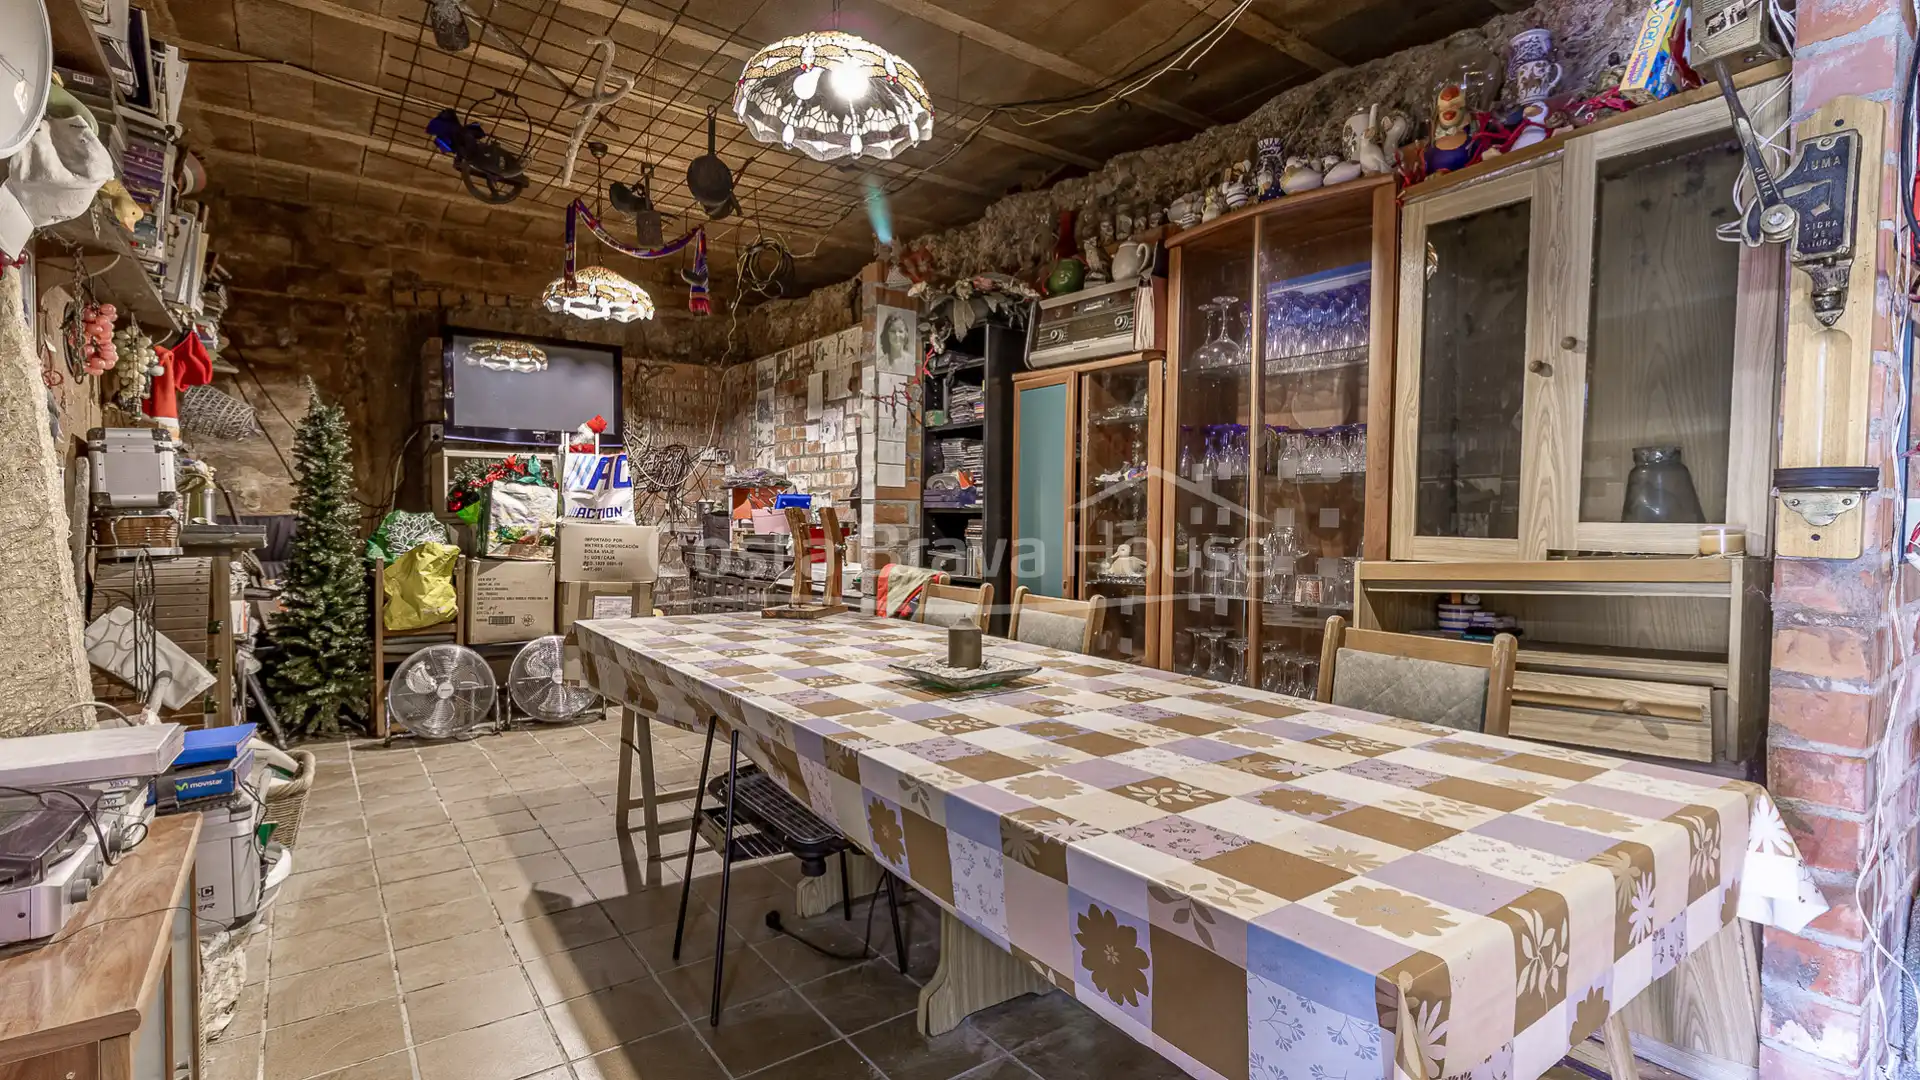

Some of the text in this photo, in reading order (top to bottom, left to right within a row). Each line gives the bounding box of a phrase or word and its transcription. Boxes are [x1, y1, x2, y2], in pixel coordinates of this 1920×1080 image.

[1803, 156, 1841, 172] JUMA
[1754, 166, 1773, 197] JUMA
[576, 506, 623, 520] ACTION
[189, 778, 223, 789] movistar
